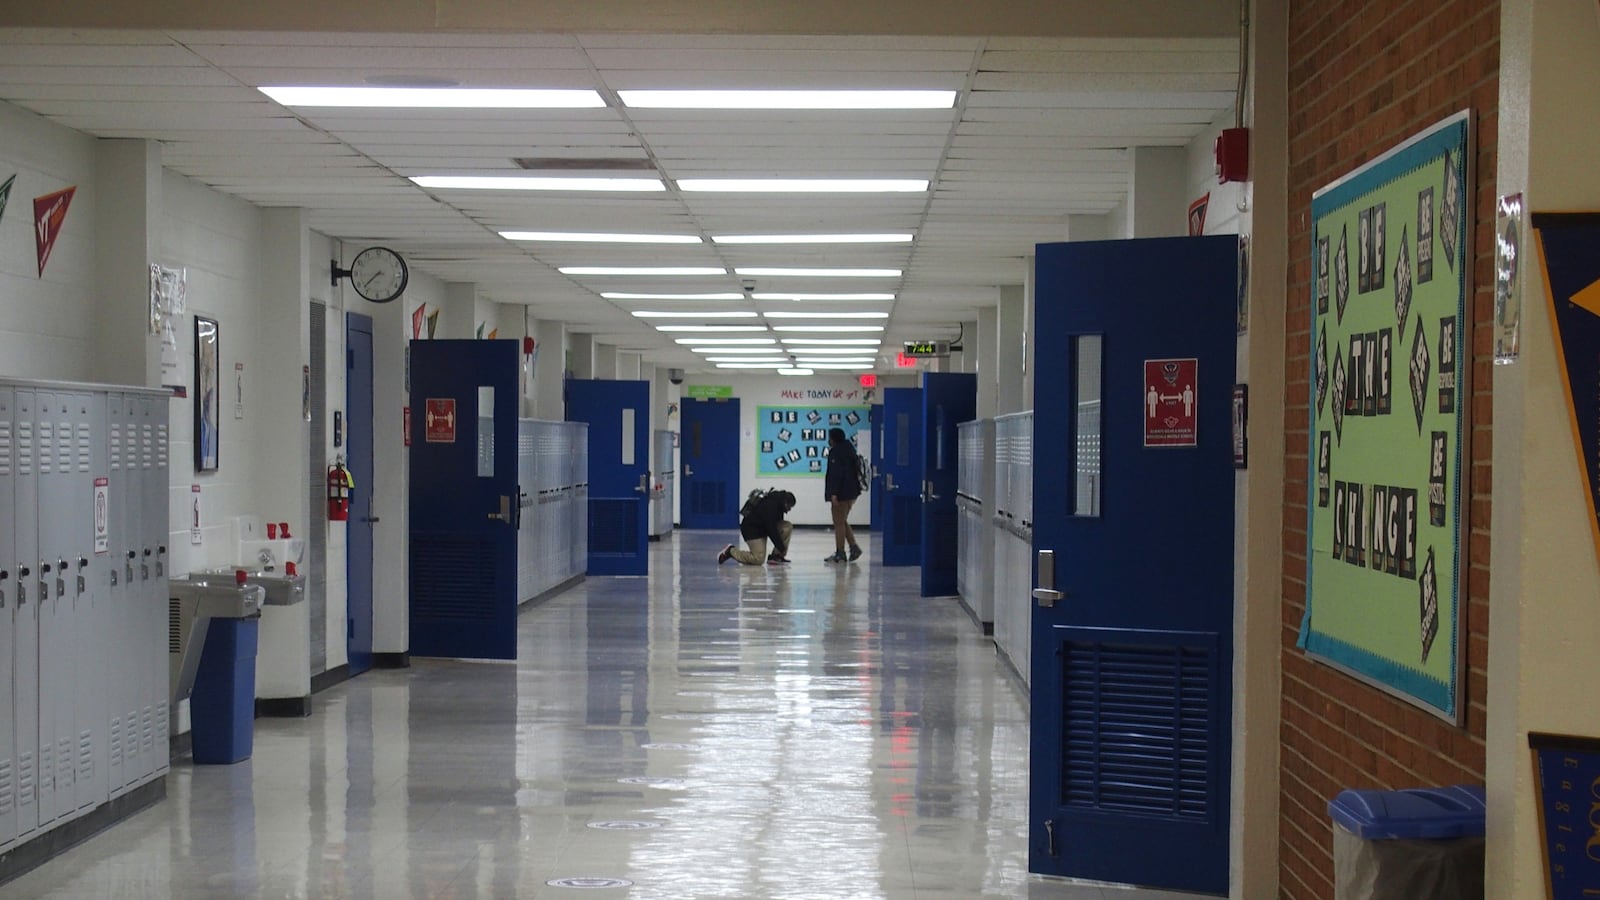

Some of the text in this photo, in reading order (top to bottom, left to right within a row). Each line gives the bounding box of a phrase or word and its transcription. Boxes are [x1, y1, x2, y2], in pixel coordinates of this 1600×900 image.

[37, 207, 52, 245] VT
[1421, 194, 1431, 236] BE
[1360, 209, 1383, 275] BE
[1442, 322, 1453, 363] BE
[1352, 333, 1389, 400] THE
[781, 389, 805, 401] MAKE
[806, 389, 832, 400] TODAY
[773, 411, 795, 423] BE
[1432, 437, 1444, 477] BE
